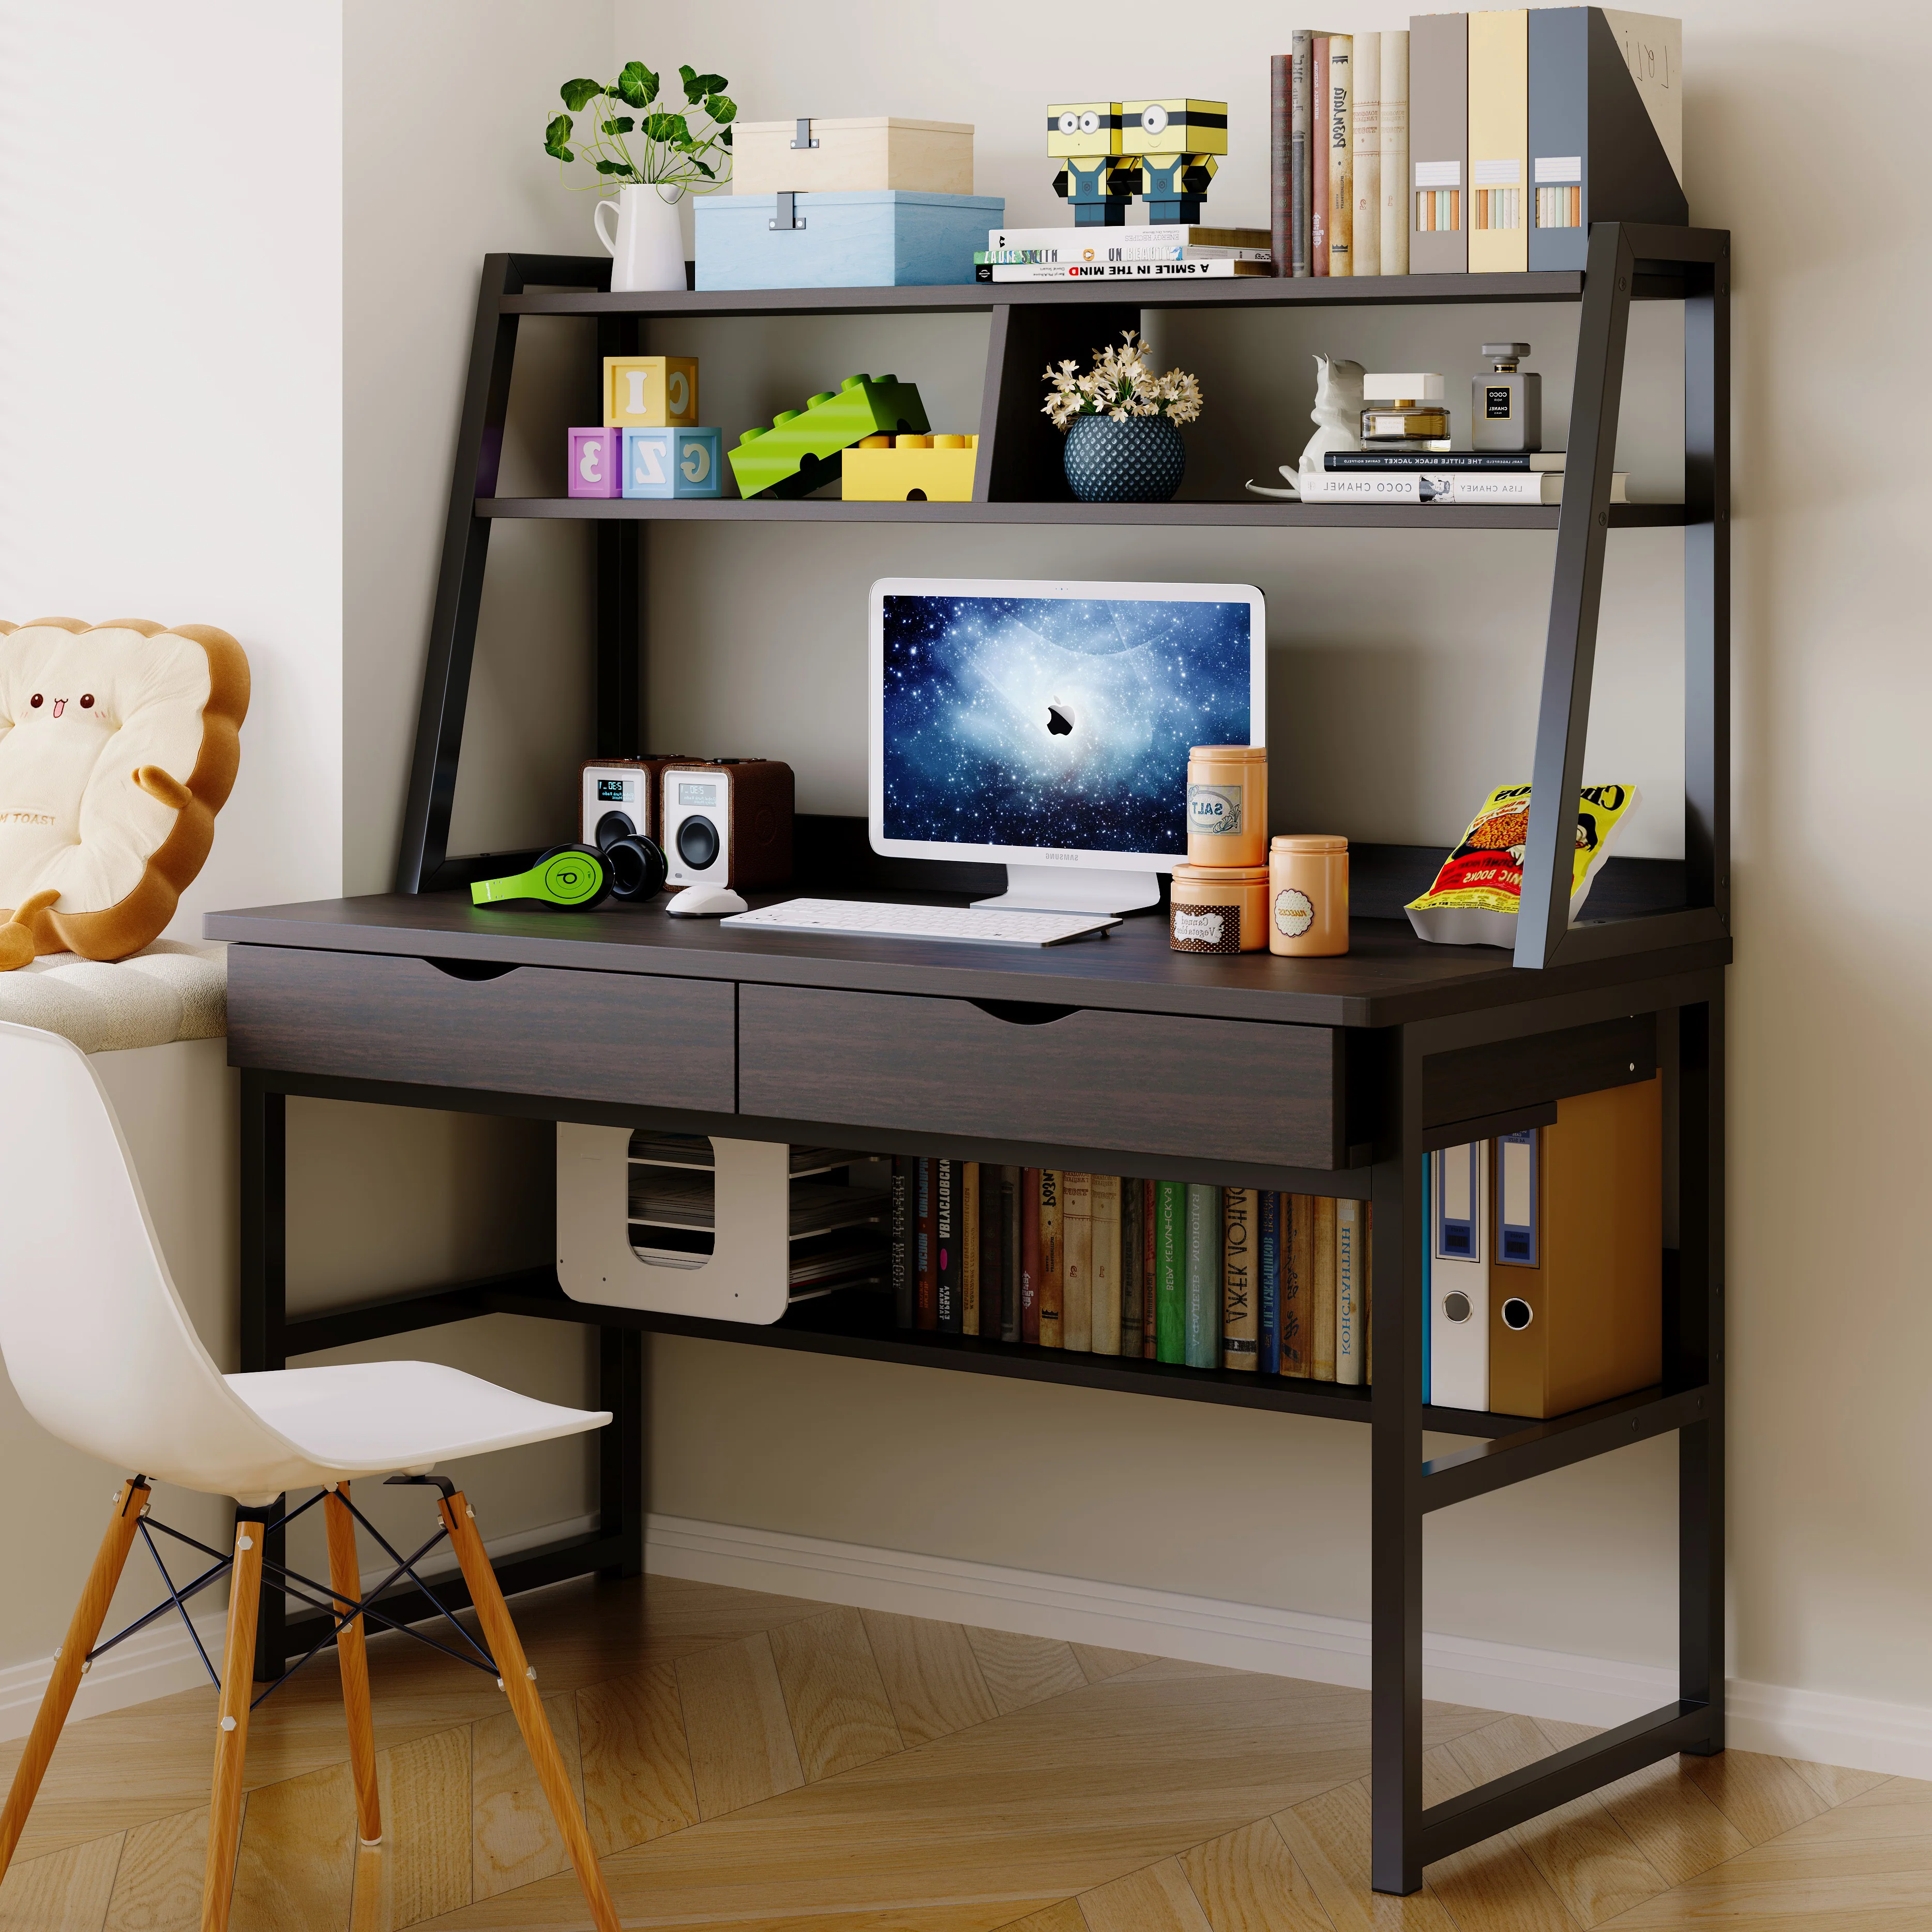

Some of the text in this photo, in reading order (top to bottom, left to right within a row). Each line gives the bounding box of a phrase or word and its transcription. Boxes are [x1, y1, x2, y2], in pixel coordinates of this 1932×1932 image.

[984, 250, 1016, 264] ZADIE
[1021, 250, 1058, 263] SMITH
[1126, 247, 1171, 261] BEAUTY
[1069, 264, 1209, 276] A SMILE IN THE MIND
[13, 813, 56, 825] TOAST
